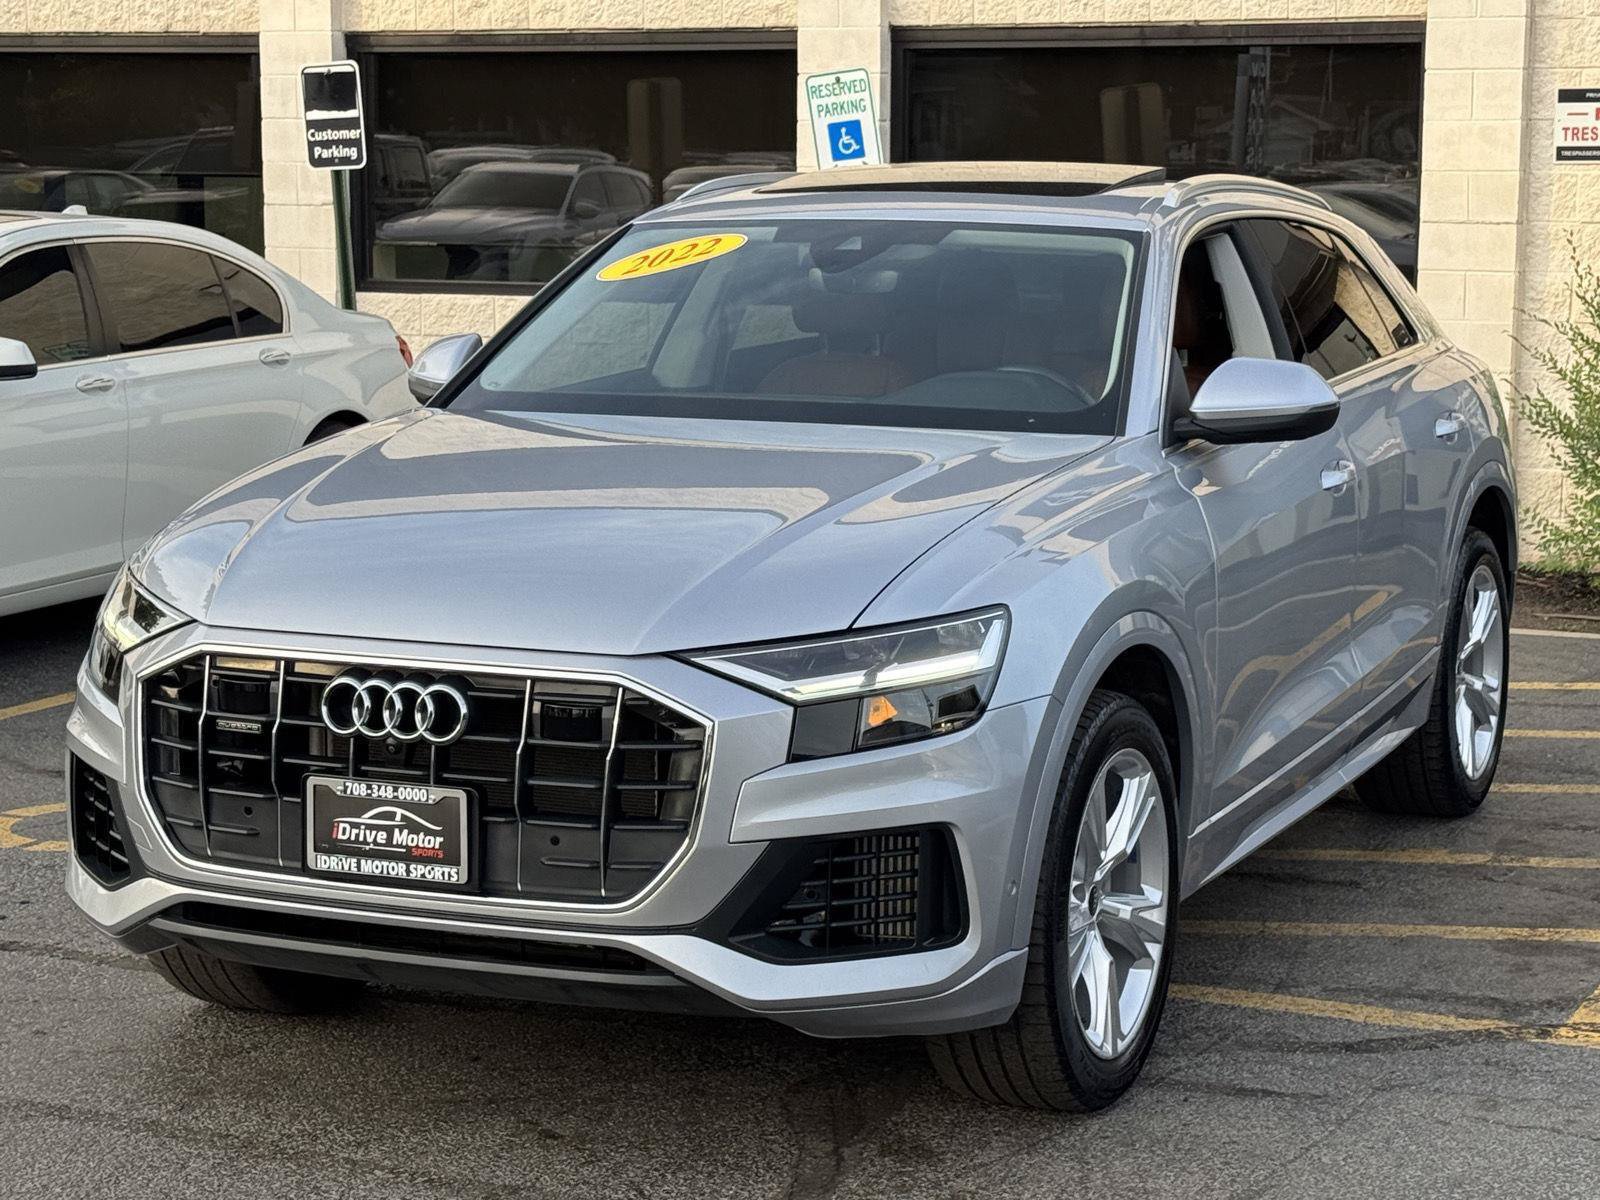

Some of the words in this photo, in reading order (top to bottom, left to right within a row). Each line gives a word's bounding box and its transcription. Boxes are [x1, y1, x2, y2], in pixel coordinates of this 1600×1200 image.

[810, 78, 867, 99] RESERVED
[816, 99, 867, 118] PARKING
[308, 129, 361, 141] Customer
[1562, 126, 1599, 141] TRES
[314, 145, 358, 160] Parking
[621, 238, 722, 275] 2022
[345, 782, 428, 802] 708-348-0000
[332, 822, 387, 844] iDrive
[392, 829, 444, 848] Motor
[412, 847, 444, 859] SPORTS
[360, 859, 406, 877] MOTOR
[409, 864, 459, 882] SPORTS
